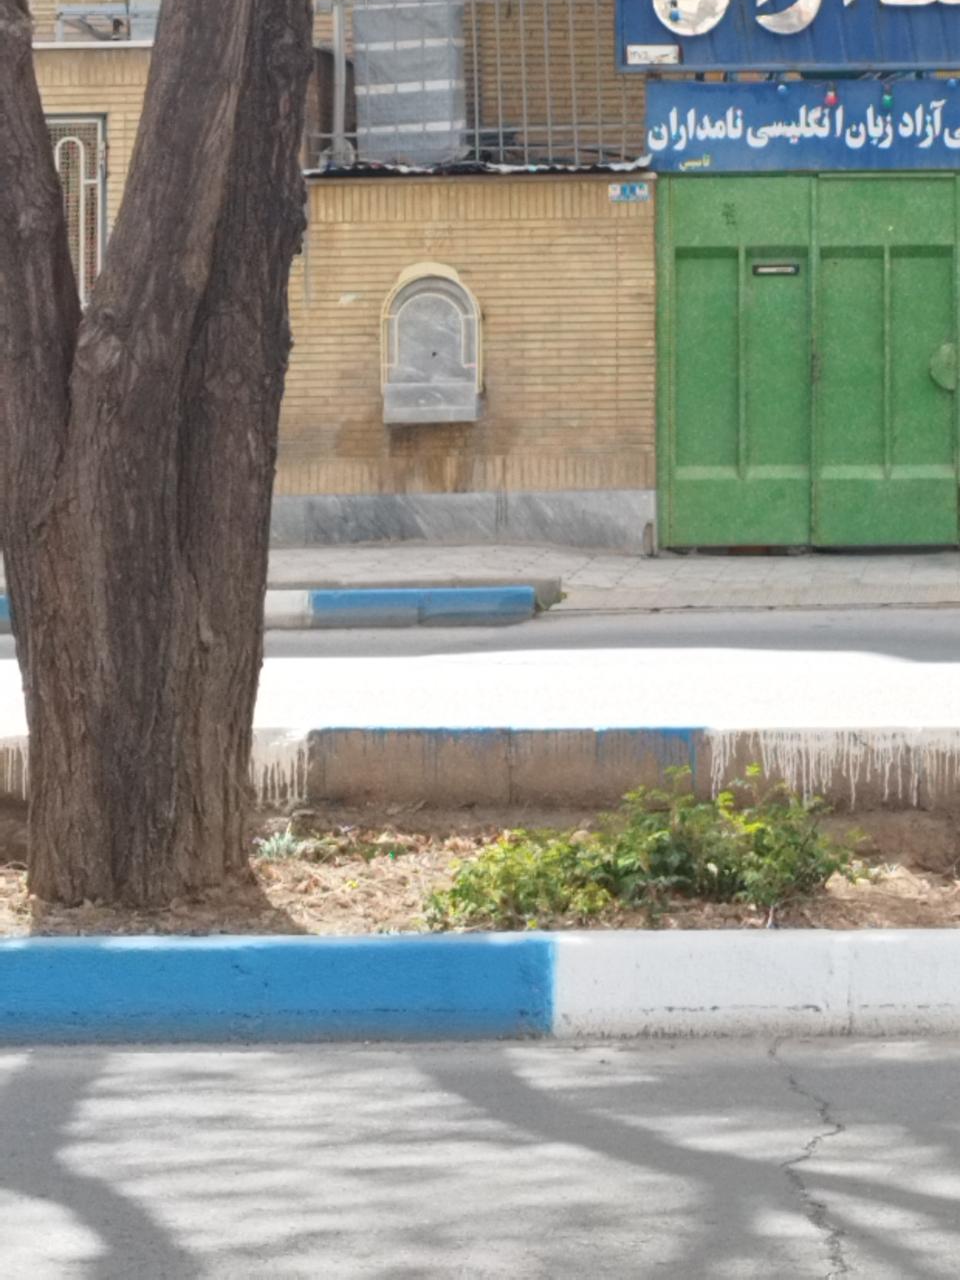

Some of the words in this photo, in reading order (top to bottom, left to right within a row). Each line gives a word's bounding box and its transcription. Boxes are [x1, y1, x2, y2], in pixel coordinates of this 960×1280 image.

[648, 105, 743, 151] نامداران
[747, 105, 843, 148] انگلیسی
[845, 104, 894, 149] زبان
[899, 99, 946, 149] آزاد
